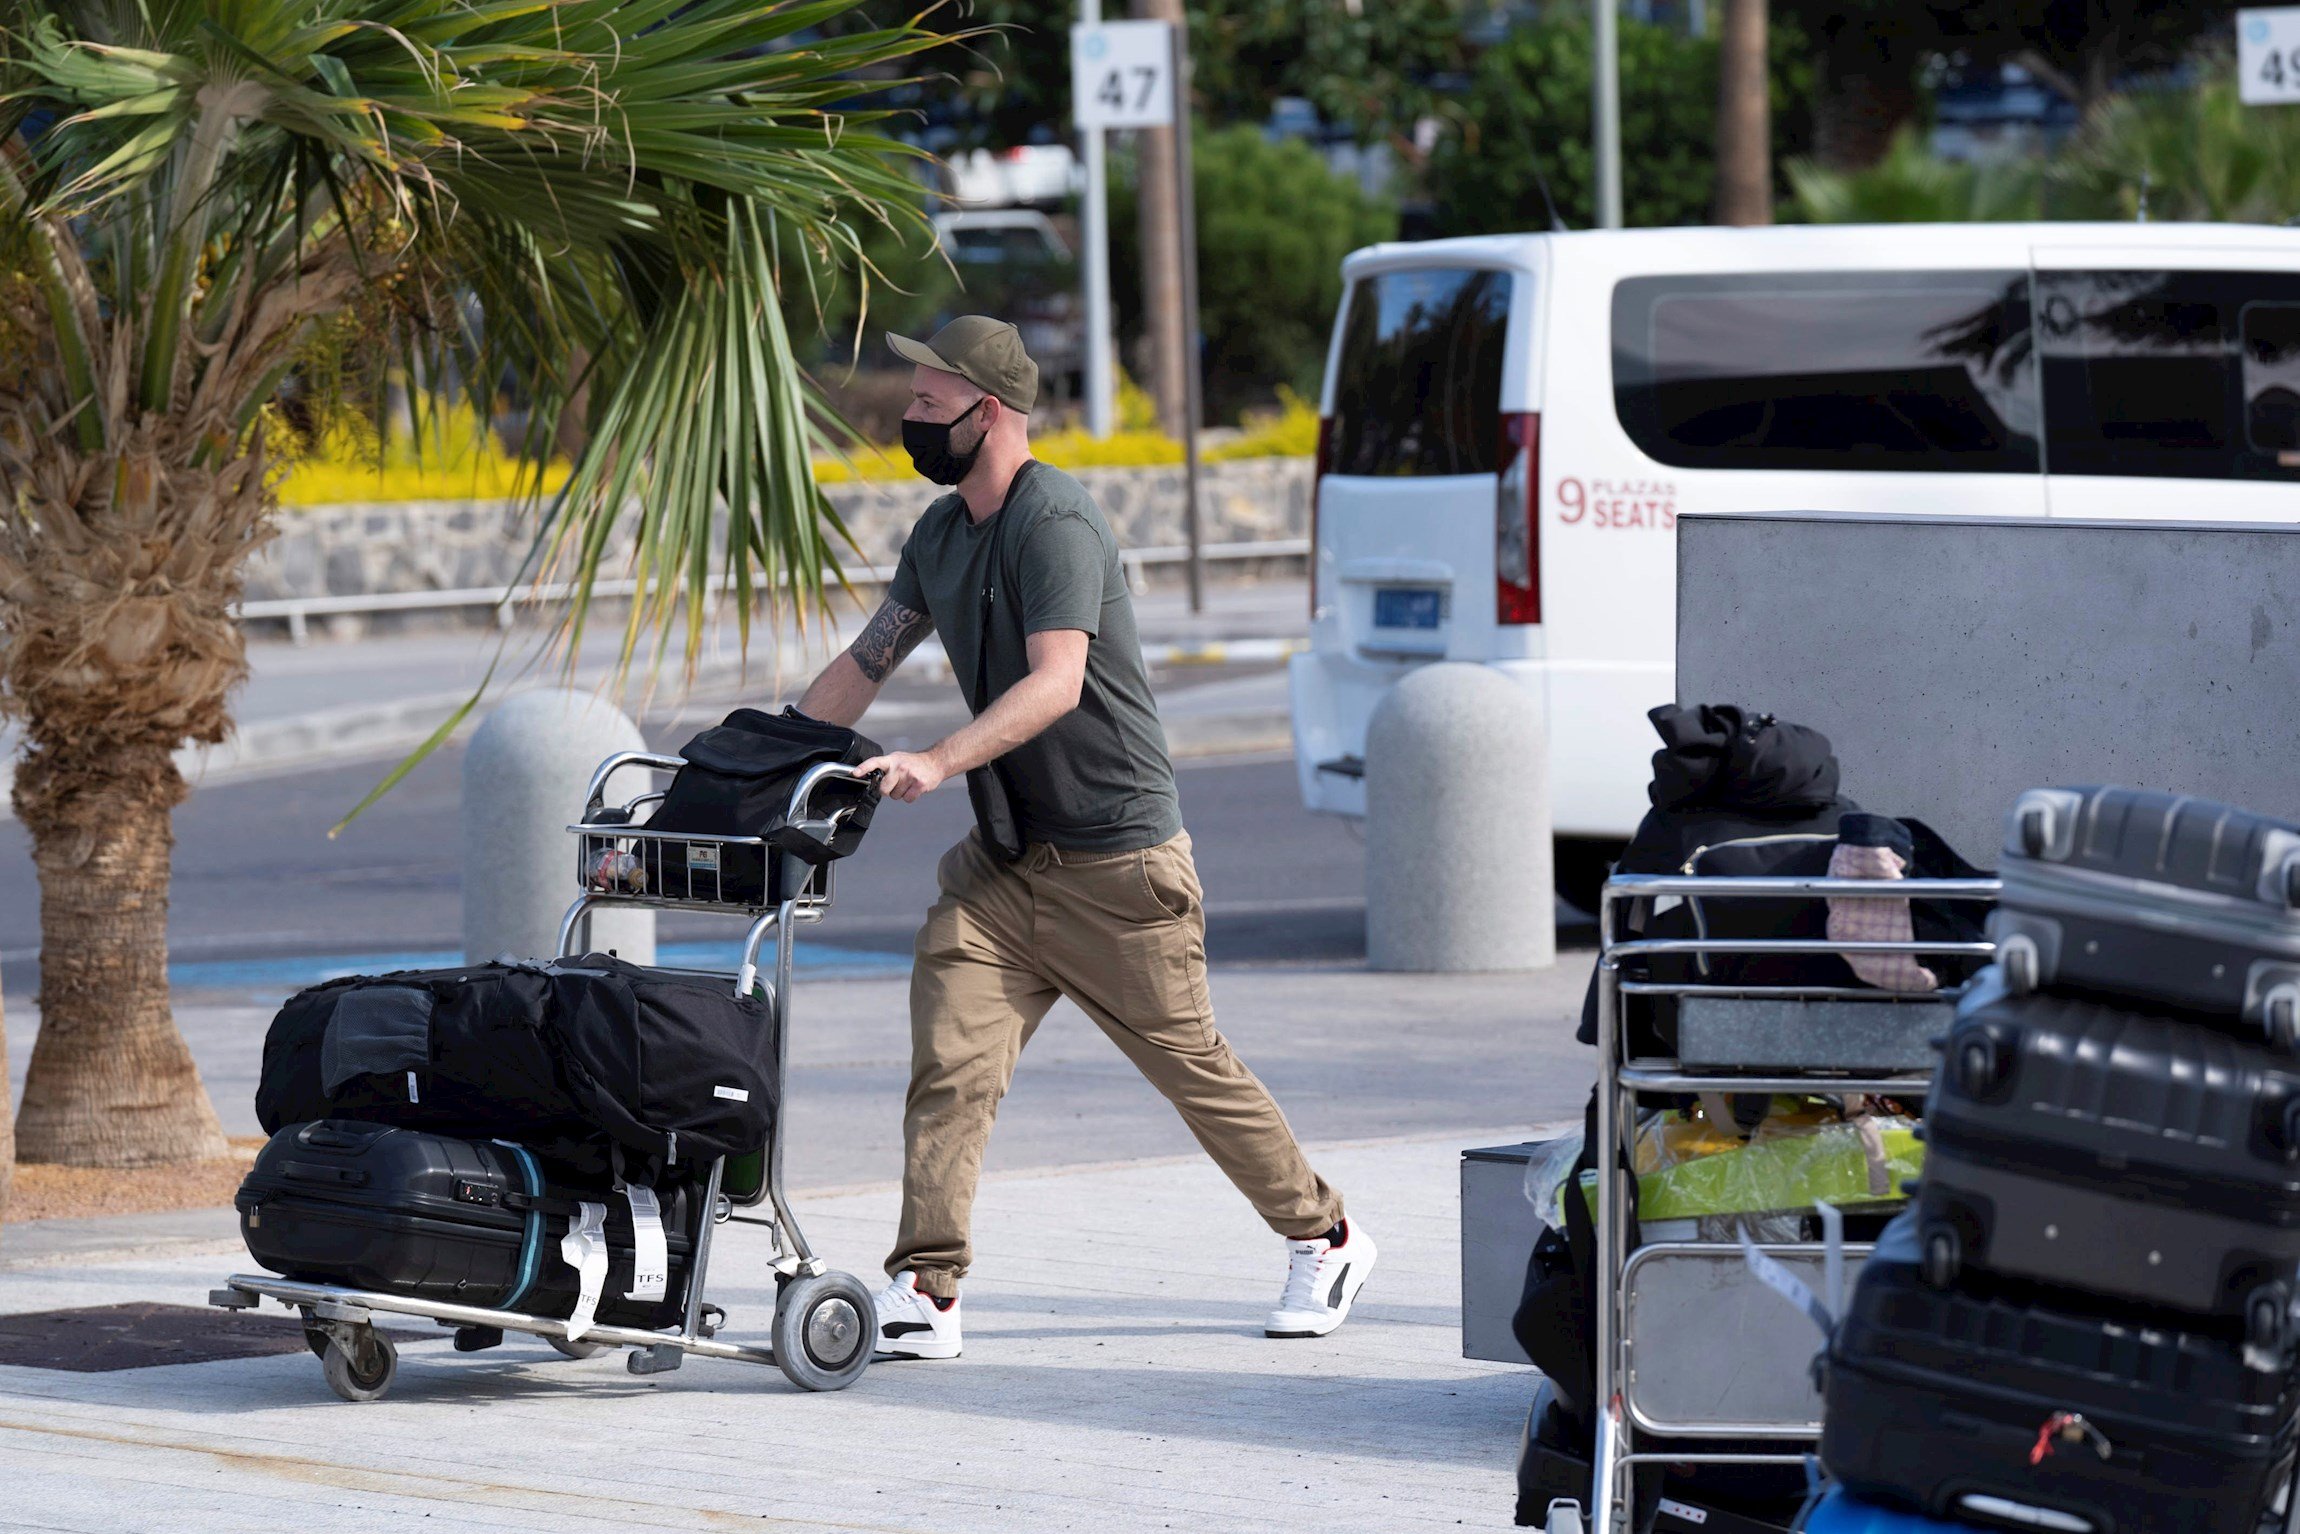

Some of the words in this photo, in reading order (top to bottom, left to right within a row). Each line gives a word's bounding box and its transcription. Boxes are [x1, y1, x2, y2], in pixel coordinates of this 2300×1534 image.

[1096, 66, 1157, 111] 47
[1557, 477, 1586, 524] 9
[1592, 480, 1676, 495] PLAZAS
[1594, 500, 1676, 529] SEATS
[636, 1273, 664, 1283] TFS
[580, 1293, 597, 1306] TFS
